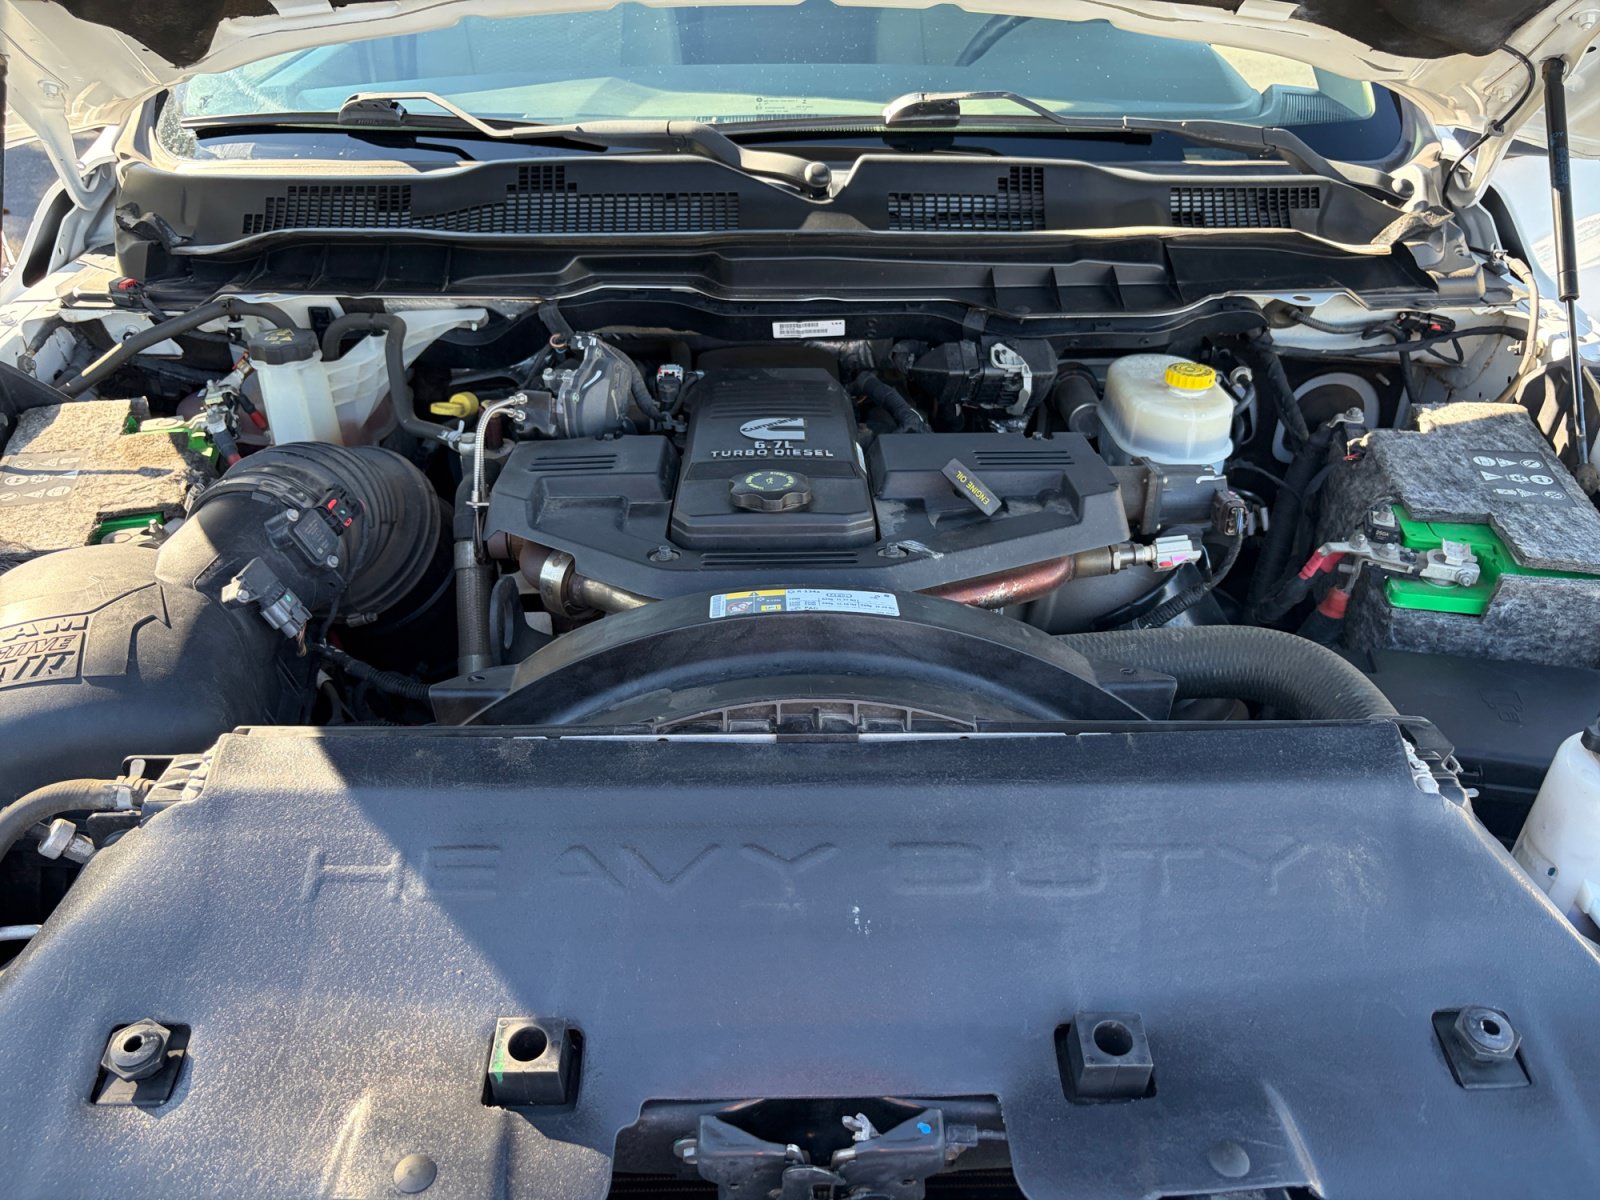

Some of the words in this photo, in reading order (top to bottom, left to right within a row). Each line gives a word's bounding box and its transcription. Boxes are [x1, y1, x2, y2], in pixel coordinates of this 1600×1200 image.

[740, 417, 799, 432] Cummins
[711, 449, 768, 457] TURBO
[774, 448, 834, 457] DIESEL
[754, 440, 794, 449] 6.7L
[956, 470, 967, 483] OIL
[966, 481, 990, 505] ENGINE
[2, 615, 89, 643] AM
[0, 634, 78, 659] CTIVE
[300, 842, 838, 902] HEAVY
[888, 839, 1312, 898] DUTY
